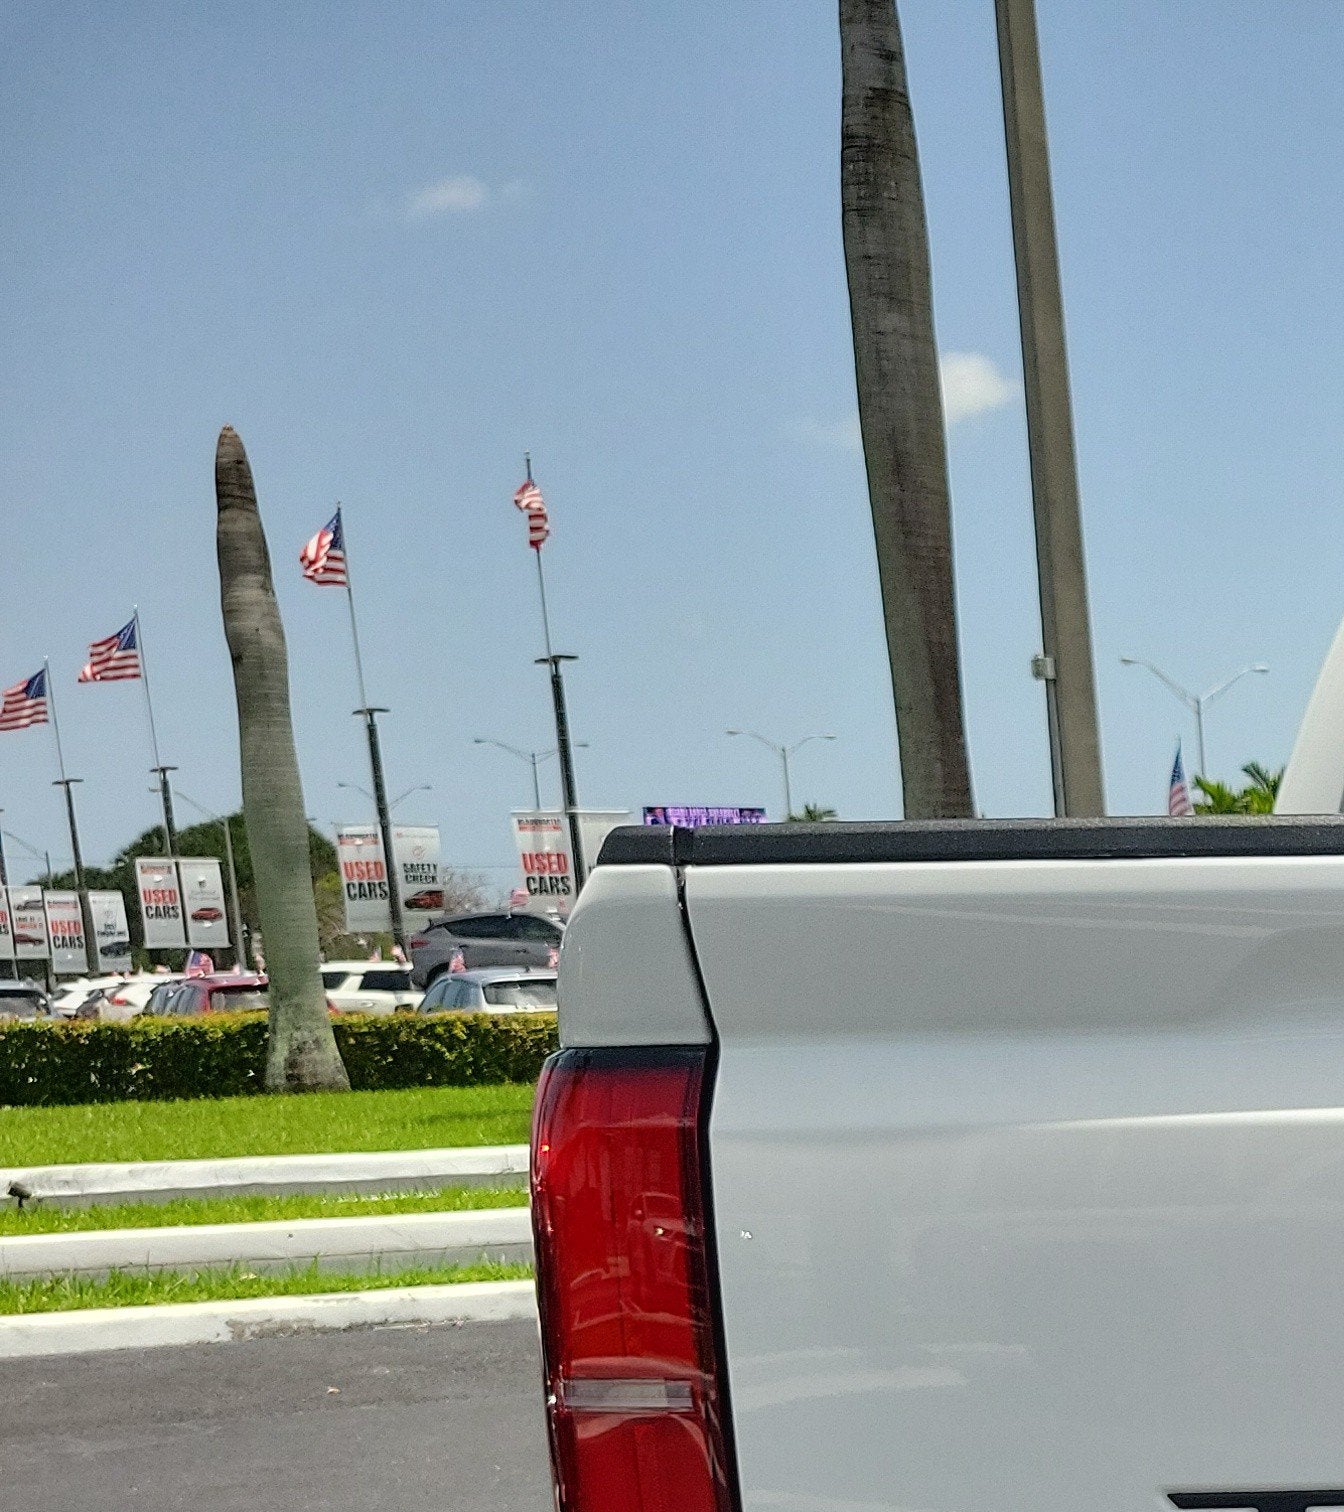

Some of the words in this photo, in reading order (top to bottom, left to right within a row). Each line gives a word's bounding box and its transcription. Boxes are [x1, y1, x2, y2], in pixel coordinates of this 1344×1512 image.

[343, 861, 386, 881] USED
[403, 863, 438, 874] SAFETY
[521, 852, 568, 875] USED
[405, 874, 438, 885] CHECK
[526, 875, 571, 896] CARS
[143, 889, 177, 904] USED
[346, 881, 389, 901] CARS
[145, 905, 180, 919] CARS
[51, 920, 81, 935] USED
[53, 935, 84, 949] CARS
